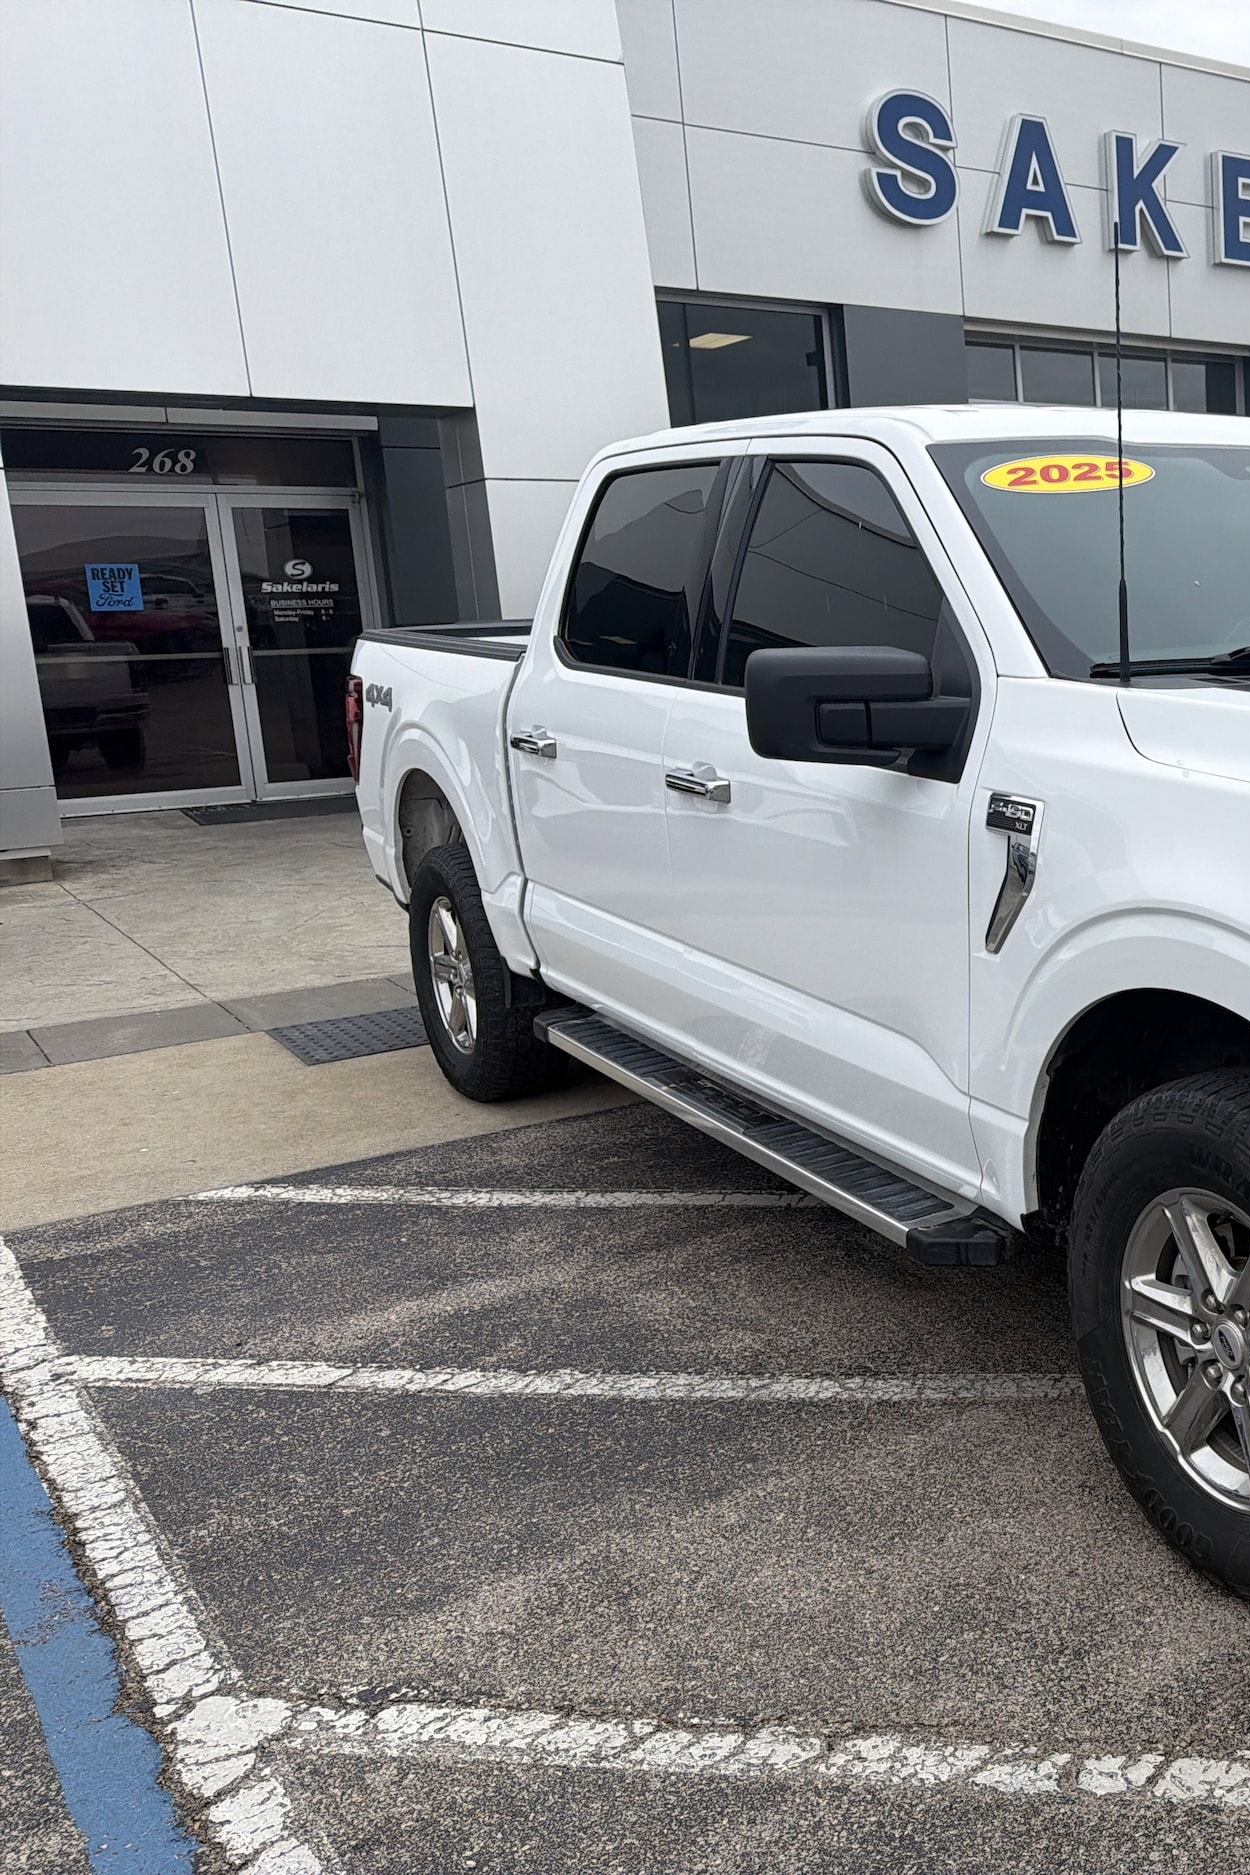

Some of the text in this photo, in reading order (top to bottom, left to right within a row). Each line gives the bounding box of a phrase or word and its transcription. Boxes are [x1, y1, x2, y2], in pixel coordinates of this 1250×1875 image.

[128, 447, 197, 475] 268
[1006, 461, 1135, 487] 2025
[91, 567, 134, 581] READY
[102, 580, 126, 593] SET
[261, 581, 339, 592] Sakelaris
[96, 592, 136, 607] Ford
[1015, 822, 1028, 831] XLT
